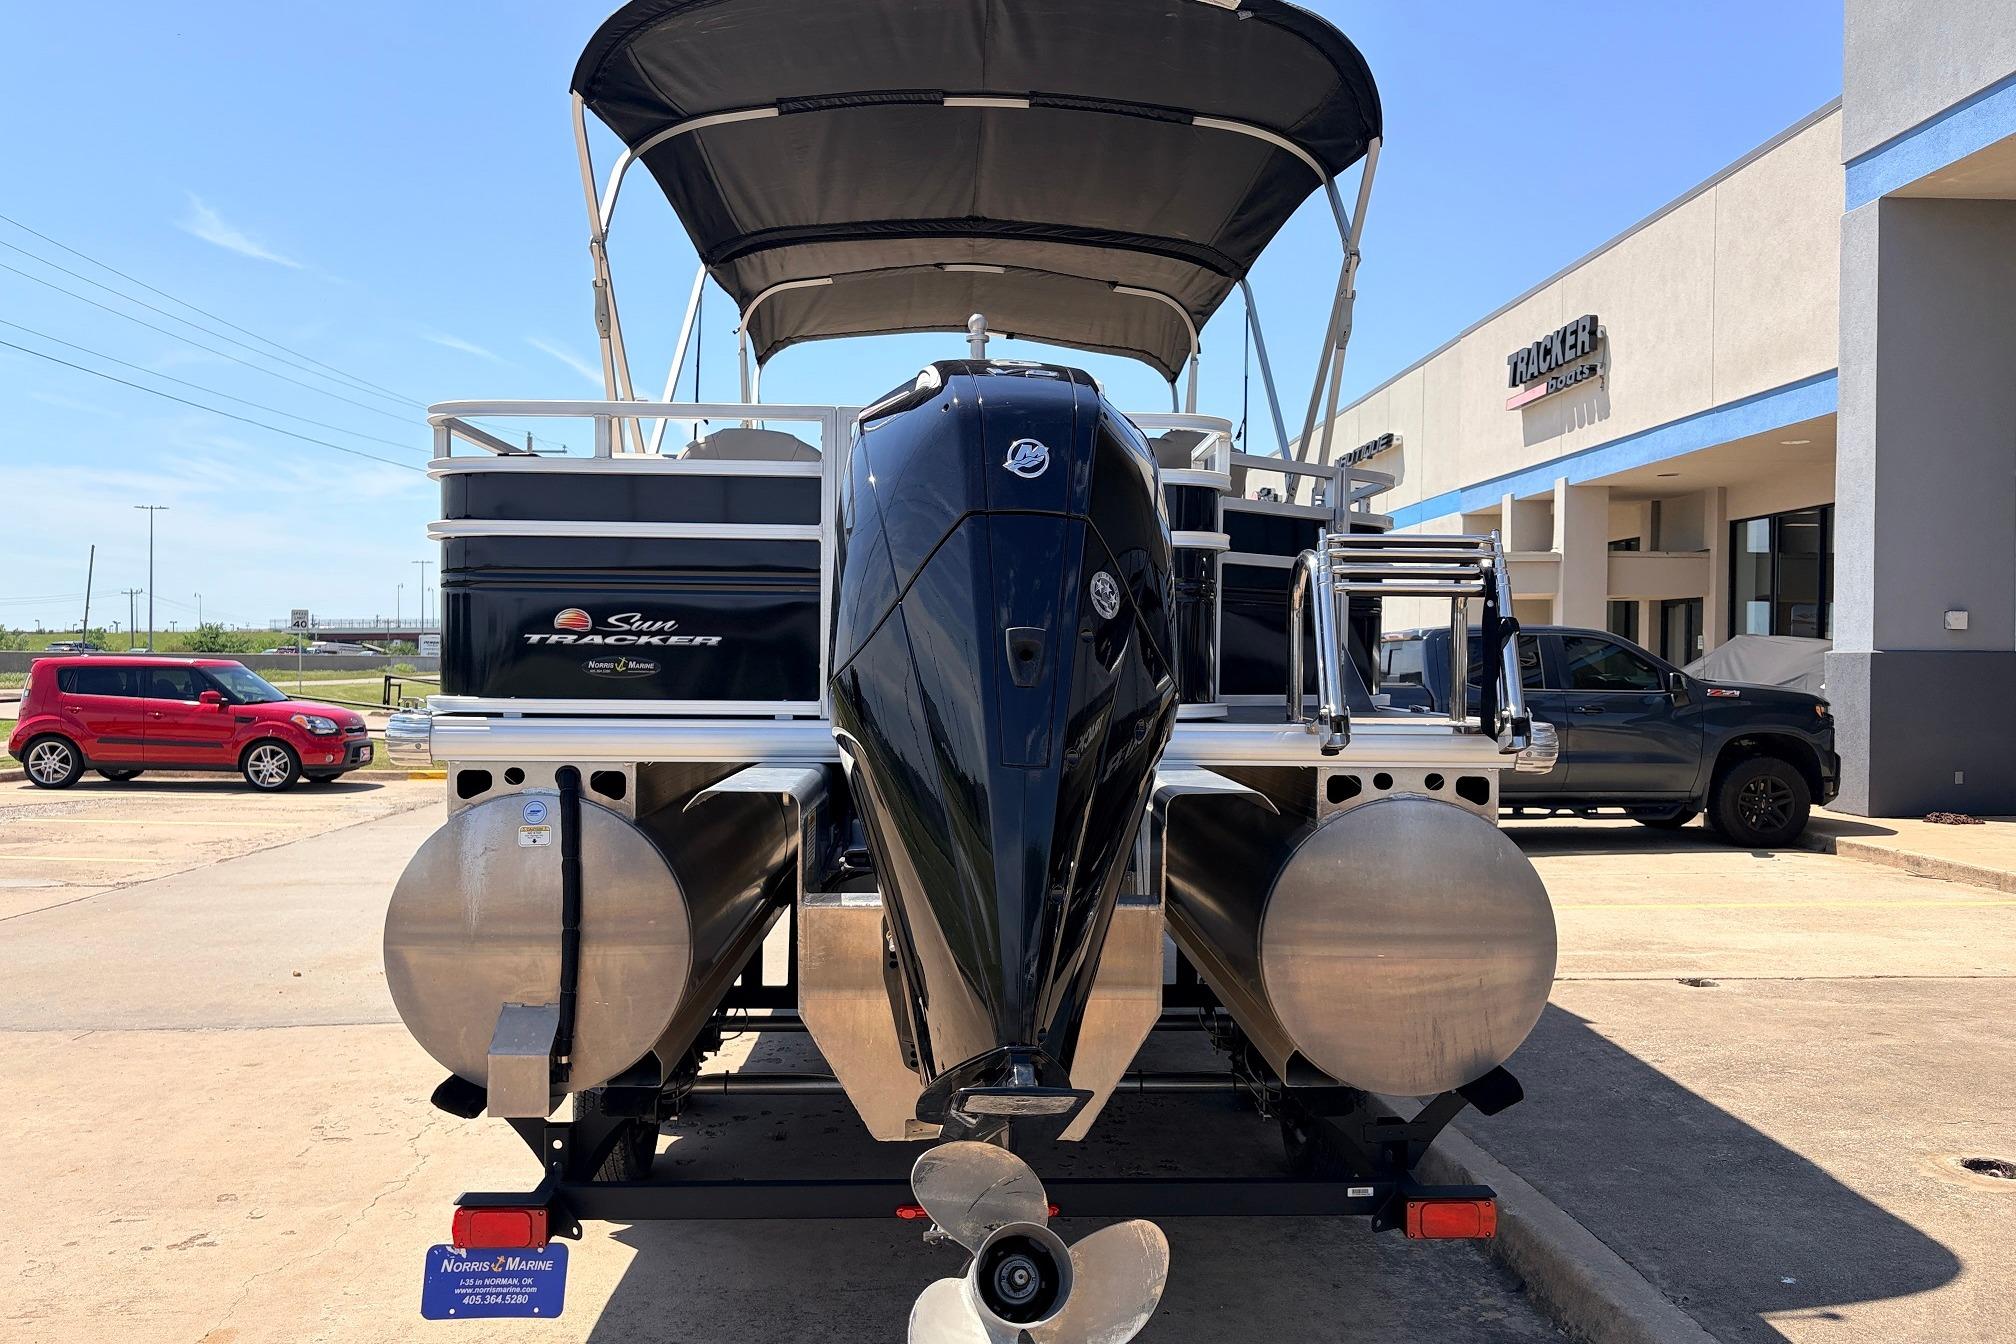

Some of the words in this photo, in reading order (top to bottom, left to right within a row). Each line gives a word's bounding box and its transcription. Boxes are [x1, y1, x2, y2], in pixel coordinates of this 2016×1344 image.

[1507, 314, 1598, 388] TRACKER
[1547, 364, 1597, 394] boats
[292, 620, 307, 628] 40
[596, 612, 679, 632] Sun
[524, 634, 722, 646] TRACKER
[588, 661, 614, 669] NORRIS
[628, 660, 655, 669] MARINE
[441, 1259, 490, 1272] NORRIS
[506, 1257, 553, 1270] MARINE
[459, 1278, 474, 1286] I-35
[475, 1278, 483, 1286] in
[483, 1277, 520, 1286] NORMAN,
[522, 1277, 534, 1285] OK
[454, 1286, 538, 1294] www.norrismarine.com
[462, 1294, 529, 1305] 405.364.5280
